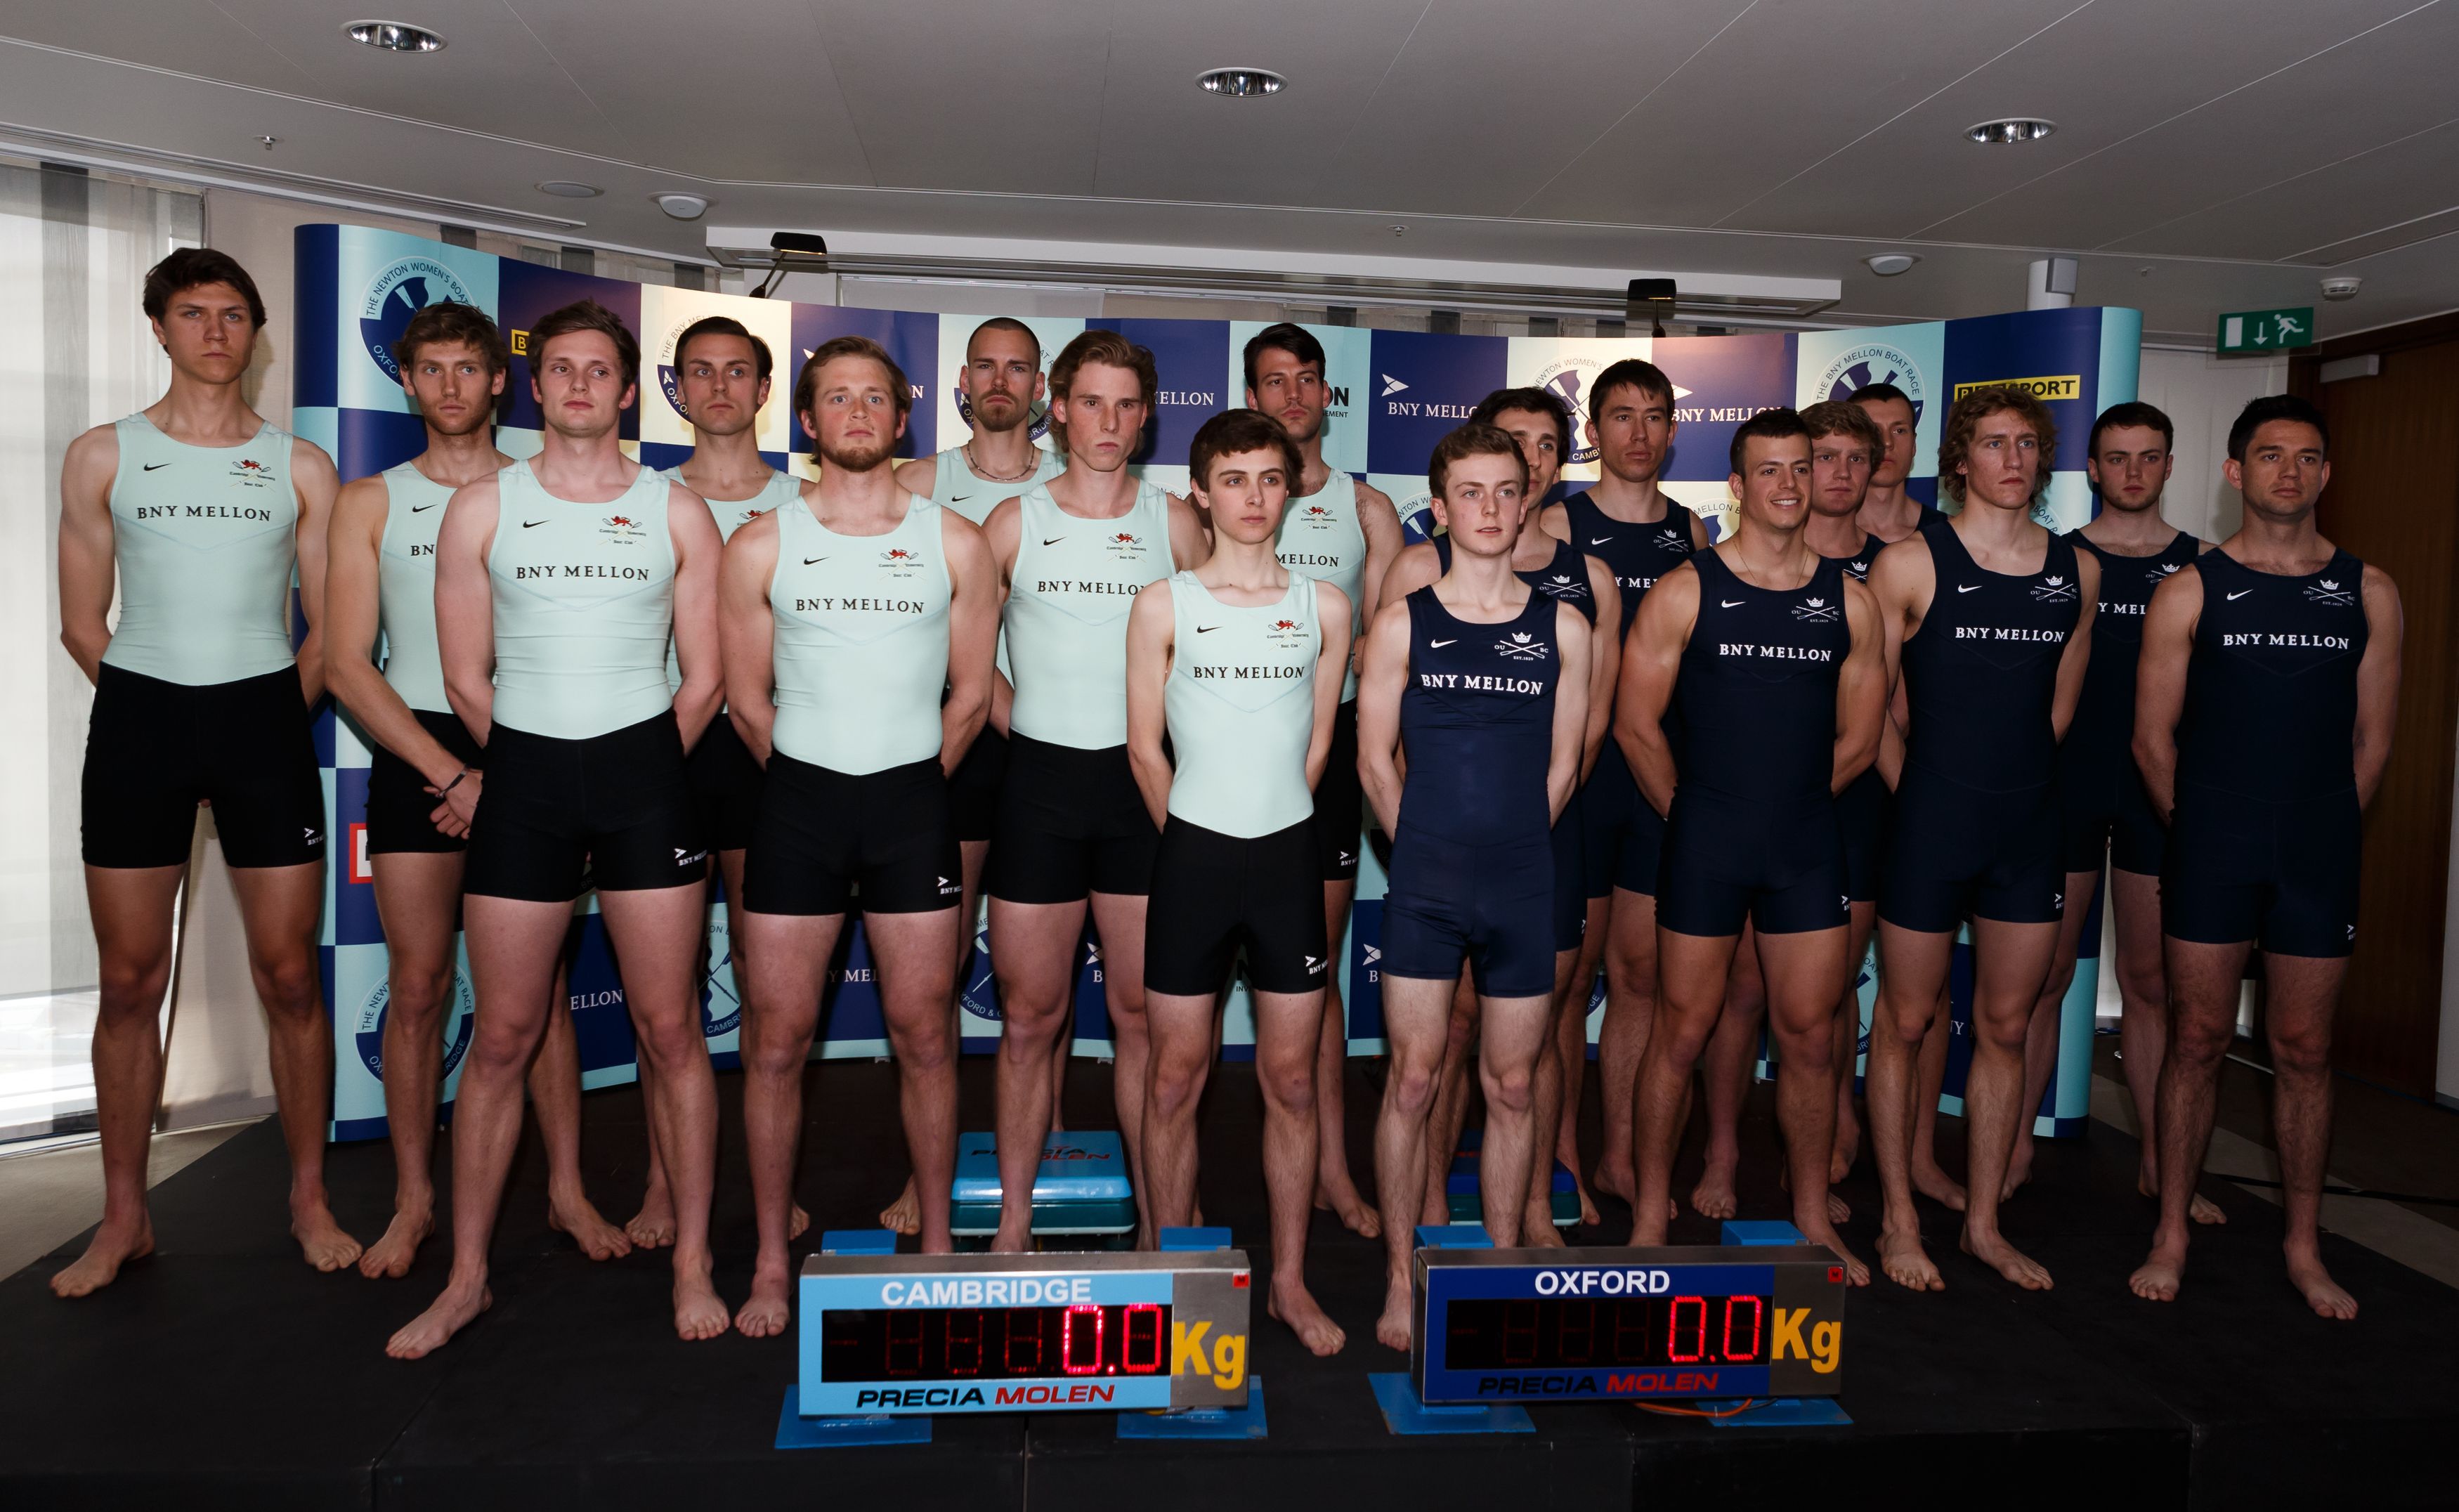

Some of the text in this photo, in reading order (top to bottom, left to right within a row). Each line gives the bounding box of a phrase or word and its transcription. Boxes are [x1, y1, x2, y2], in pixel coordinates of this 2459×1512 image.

[367, 262, 469, 315] THE NEWTON WOMEN'S BOAT
[662, 322, 686, 359] THE BNY
[1564, 358, 1604, 370] WOMEN'S
[1817, 348, 1919, 400] THE BNY MELLON BOAT RACE
[1388, 402, 1421, 416] BNY
[1572, 448, 1600, 461] CAMB
[137, 506, 271, 521] BNY MELLON
[411, 545, 435, 556] BN
[1275, 554, 1339, 567] MELLON
[516, 566, 650, 580] BNY MELLON
[1038, 581, 1145, 596] BNY MELLO
[796, 599, 925, 613] BNY MELLON
[1955, 627, 2064, 642] BNY MELLON
[2223, 634, 2349, 649] BNY MELLON
[1719, 644, 1832, 661] BNY MELLON
[1193, 666, 1305, 679] BNY MELLON
[1421, 674, 1543, 695] BNY MELLON
[1309, 964, 1321, 975] BNY
[461, 988, 472, 1011] RACE
[570, 989, 624, 1010] ELLON
[362, 1011, 374, 1029] THE
[1534, 1270, 1670, 1294] OXFORD
[882, 1279, 1092, 1306] CAMBRIDGE
[1668, 1296, 1761, 1362] 0.0
[1063, 1303, 1163, 1375] 0.0
[1772, 1308, 1841, 1374] Kg
[1173, 1320, 1246, 1390] Kg
[1478, 1372, 1719, 1395] PRECIA MOLEN
[856, 1385, 1115, 1408] PRECIA MOLEN
